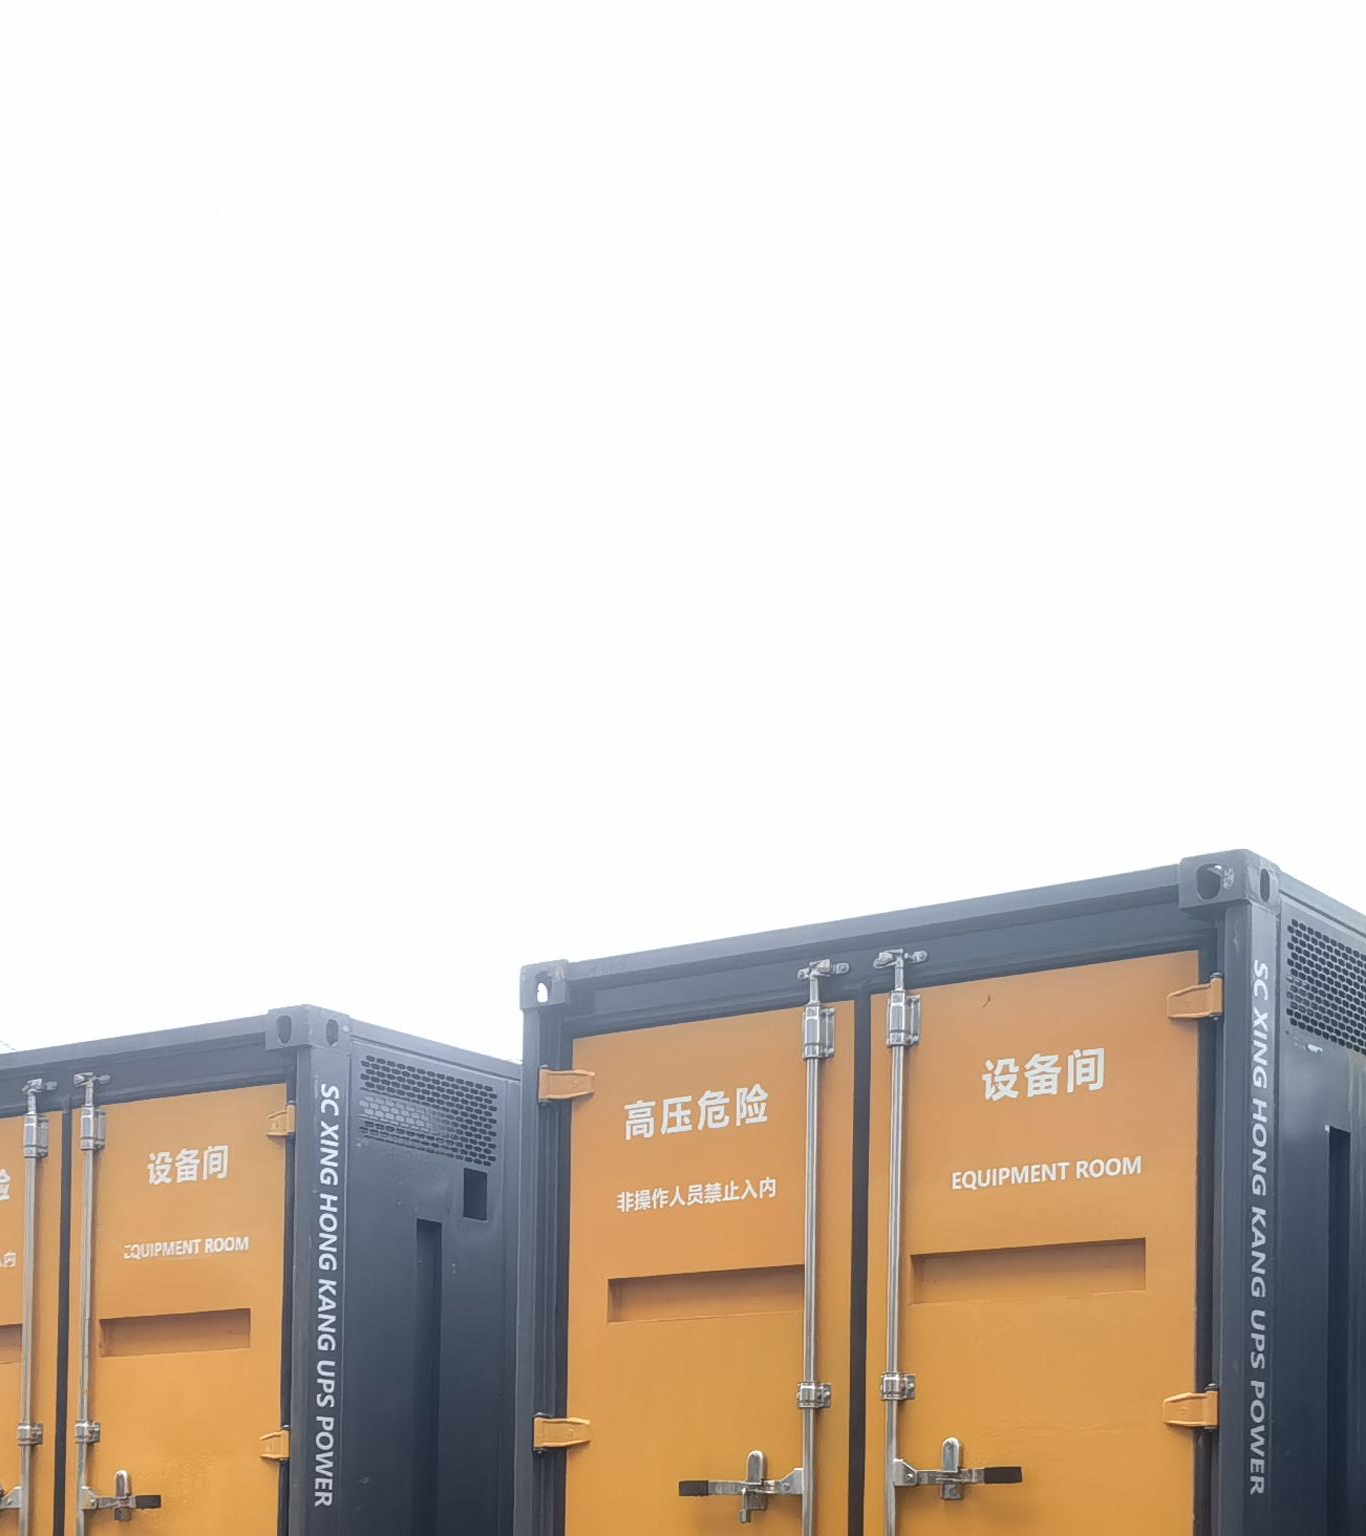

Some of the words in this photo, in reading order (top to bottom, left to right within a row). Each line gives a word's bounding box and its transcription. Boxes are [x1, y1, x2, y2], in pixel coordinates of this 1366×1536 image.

[1253, 960, 1268, 1001] SC
[981, 1048, 1105, 1102] 设备间
[1252, 1006, 1268, 1088] XING
[320, 1083, 340, 1117] SC
[623, 1084, 769, 1140] 高压危险
[147, 1145, 229, 1186] 设备间
[319, 1121, 339, 1186] XING
[951, 1161, 1070, 1191] EQUIPMENT
[1075, 1155, 1142, 1179] ROOM
[1251, 1097, 1267, 1196] HONG
[617, 1176, 777, 1213] 非操作人员禁止入内
[205, 1236, 250, 1253] ROOM
[318, 1193, 339, 1272] HONG
[1250, 1206, 1267, 1298] KANG
[317, 1278, 337, 1351] KANG
[1250, 1309, 1266, 1370] UPS
[316, 1360, 335, 1408] UPS
[314, 1415, 334, 1507] POWER
[1249, 1380, 1266, 1495] POWER
